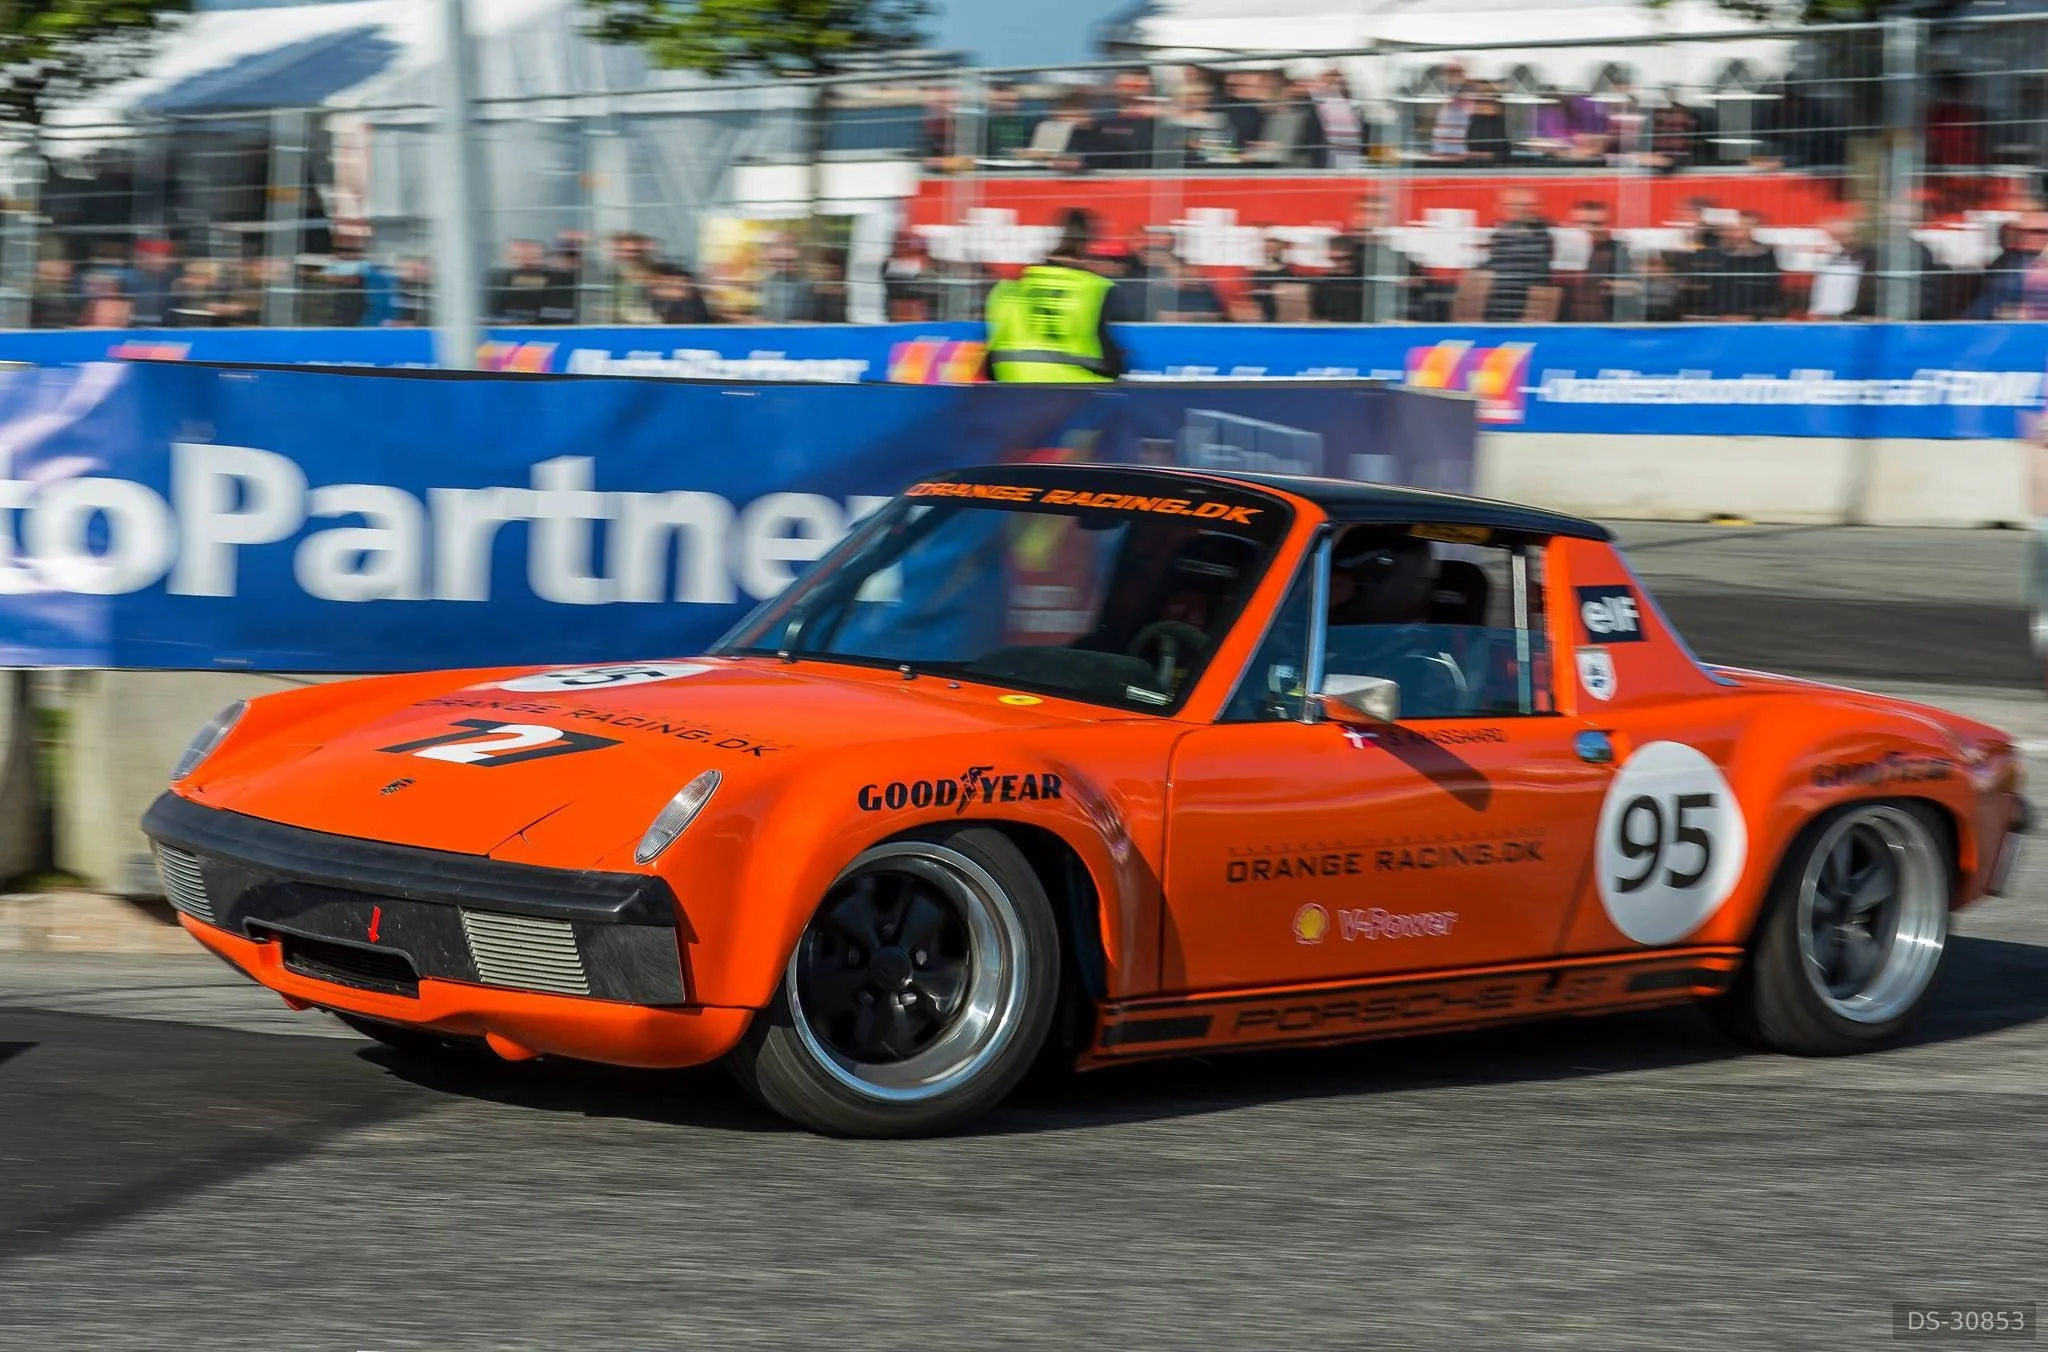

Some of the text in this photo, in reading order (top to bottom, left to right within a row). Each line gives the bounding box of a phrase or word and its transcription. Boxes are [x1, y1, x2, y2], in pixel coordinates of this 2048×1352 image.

[904, 482, 1263, 525] ORANGE RACING.DK
[1581, 596, 1640, 634] elf
[573, 703, 782, 758] RACING.DK
[857, 770, 1063, 813] GOODYEAR
[1226, 852, 1362, 884] ORANGE
[1374, 840, 1547, 873] RACING.DK
[1614, 793, 1719, 893] 95
[1338, 907, 1459, 941] V-Power
[1232, 984, 1520, 1036] PORSCHE
